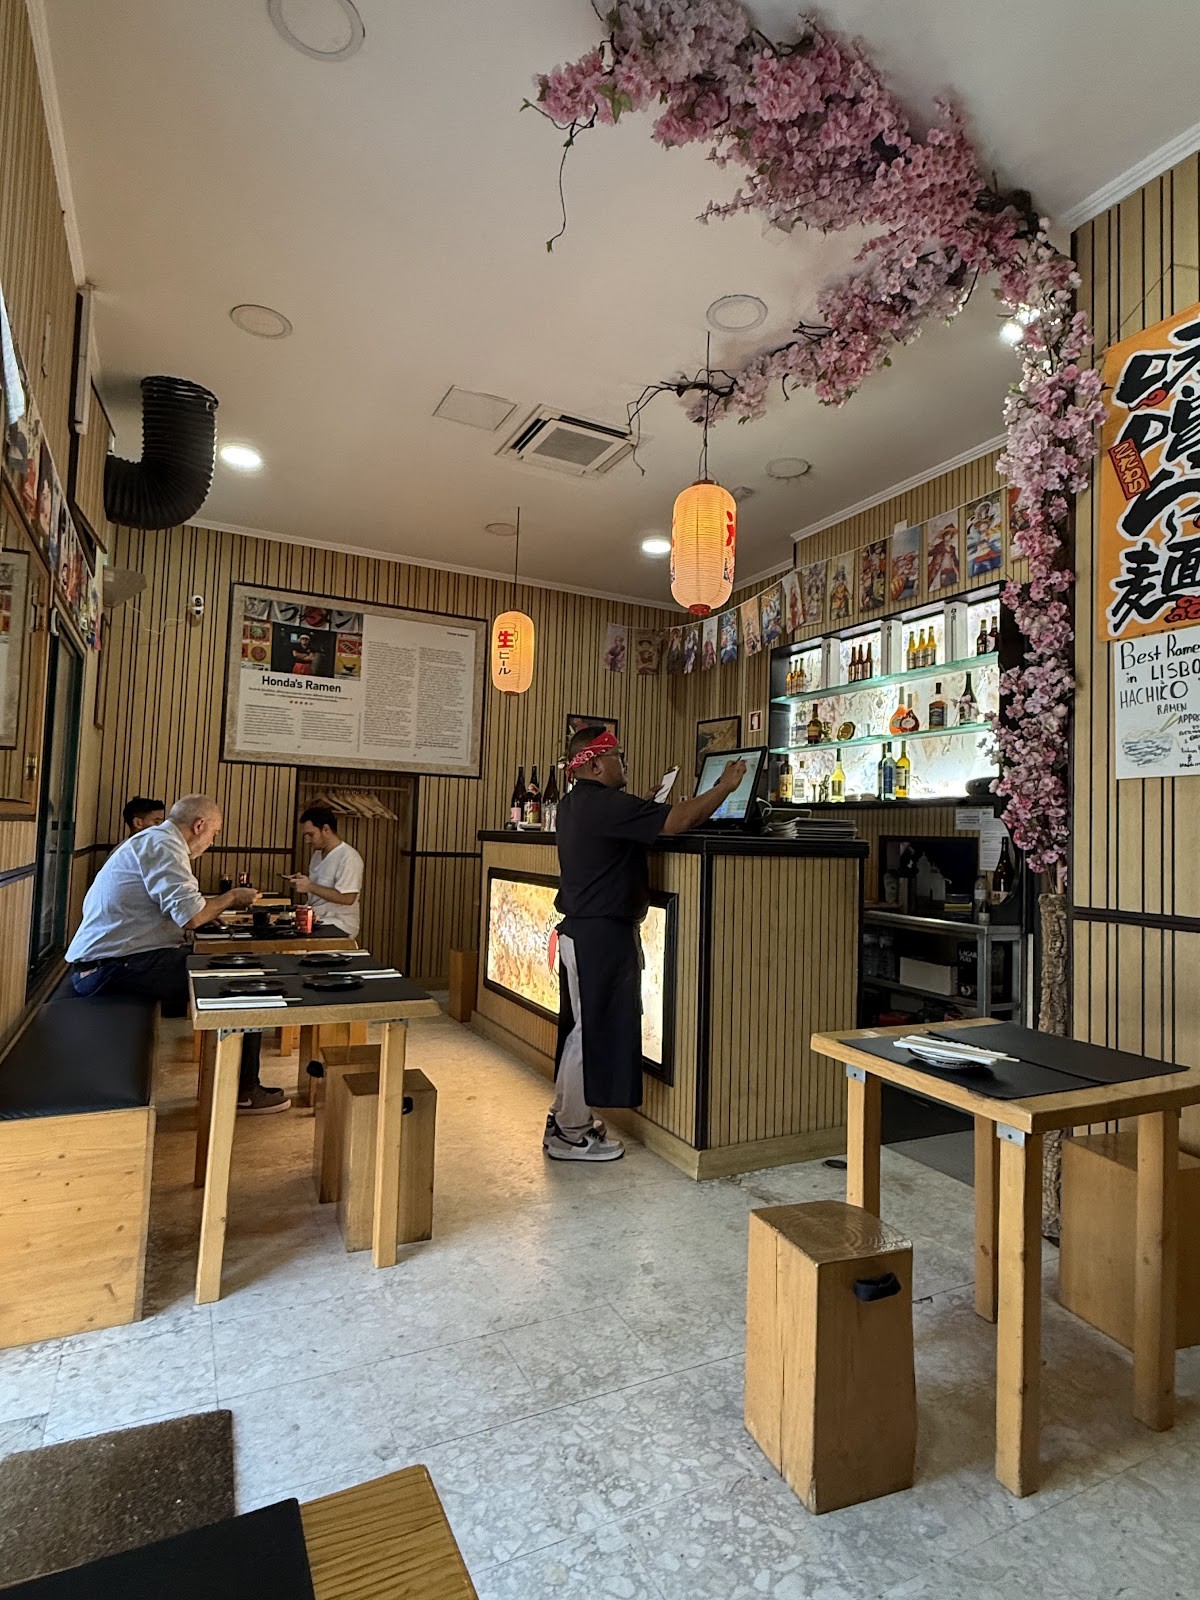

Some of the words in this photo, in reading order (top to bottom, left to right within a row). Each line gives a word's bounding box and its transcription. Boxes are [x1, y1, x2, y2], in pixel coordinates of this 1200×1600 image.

[498, 631, 515, 675] 生ビール
[1120, 641, 1161, 670] Best
[262, 676, 303, 689] Honda's
[305, 680, 341, 693] Ramen
[1126, 672, 1137, 683] in
[1157, 703, 1187, 715] RAMEN
